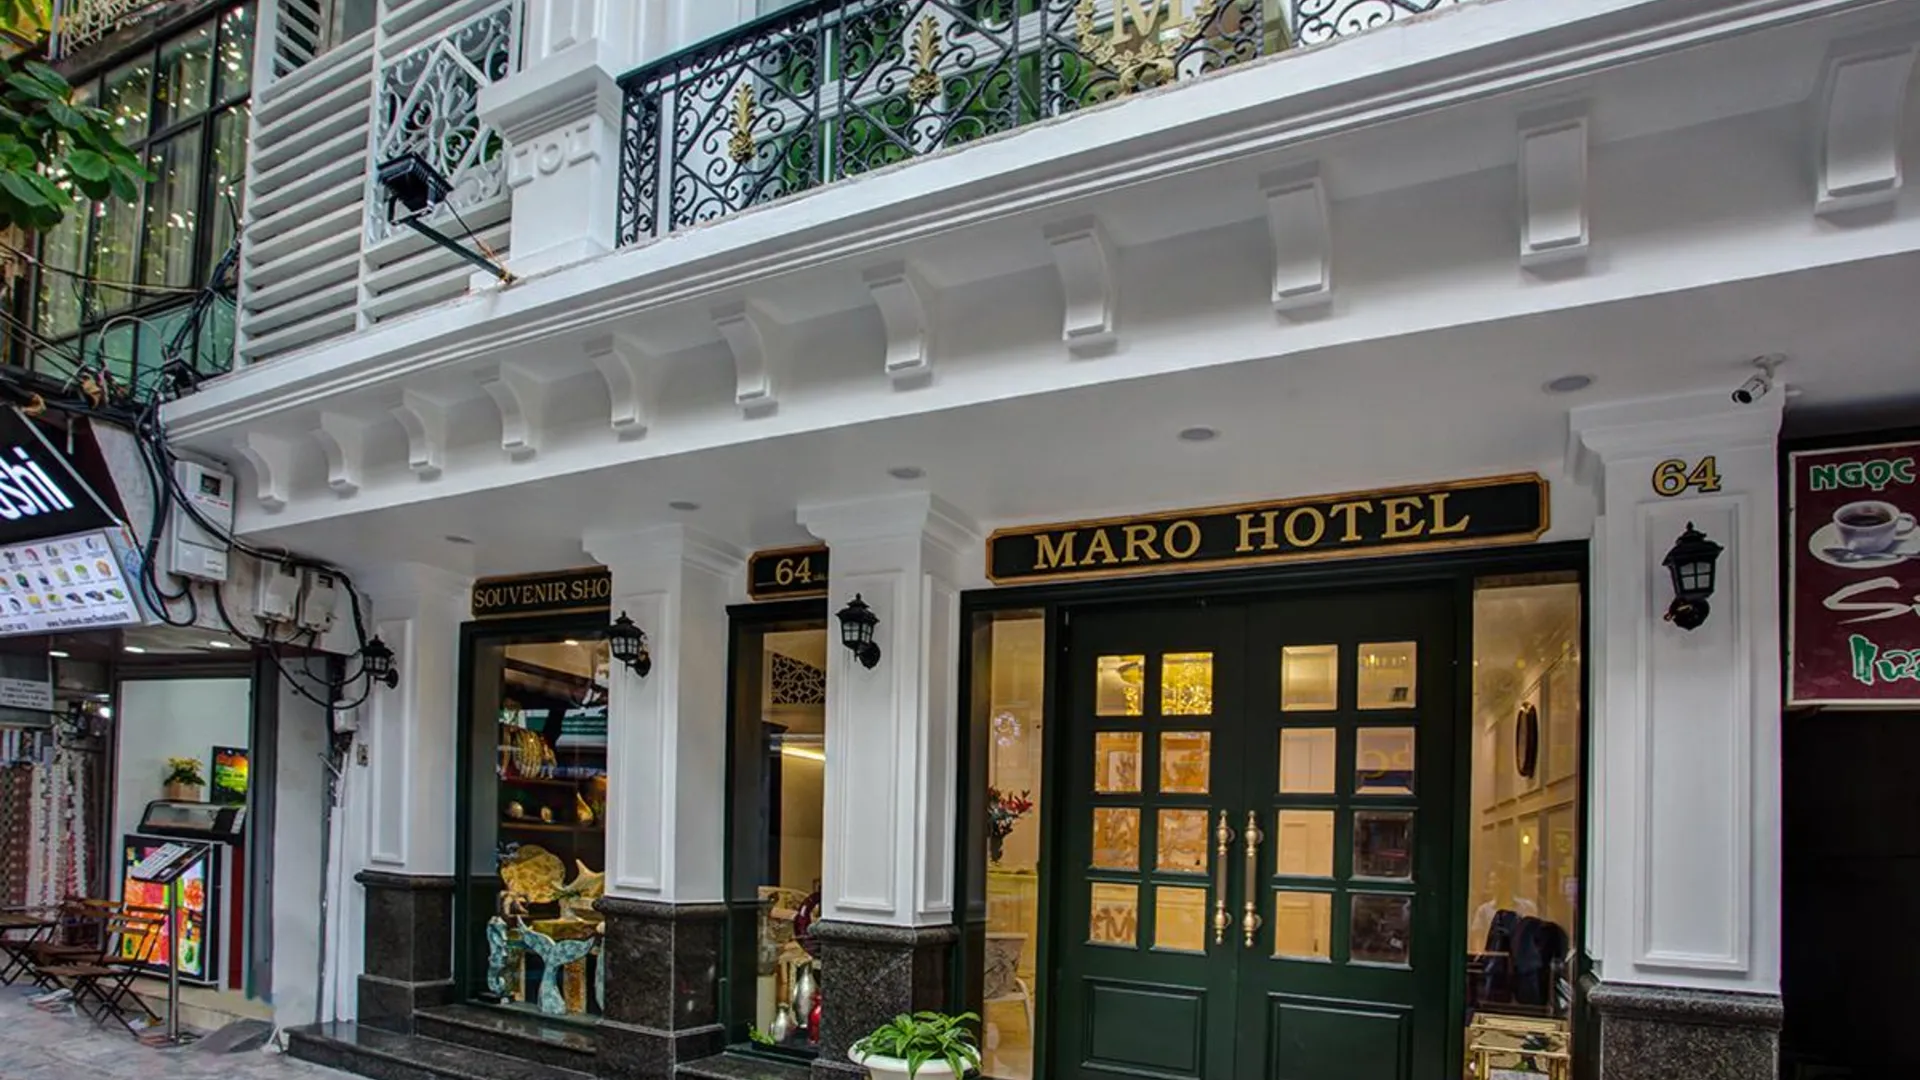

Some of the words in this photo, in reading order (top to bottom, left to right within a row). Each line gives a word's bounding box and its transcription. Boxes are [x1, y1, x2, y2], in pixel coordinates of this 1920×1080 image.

[1111, 0, 1189, 44] M
[1652, 455, 1722, 497] 64
[1809, 458, 1915, 492] NGỌC
[1033, 519, 1202, 570] MARO
[1235, 492, 1471, 553] HOTEL
[775, 556, 812, 586] 64
[474, 581, 567, 608] SOUVENIR
